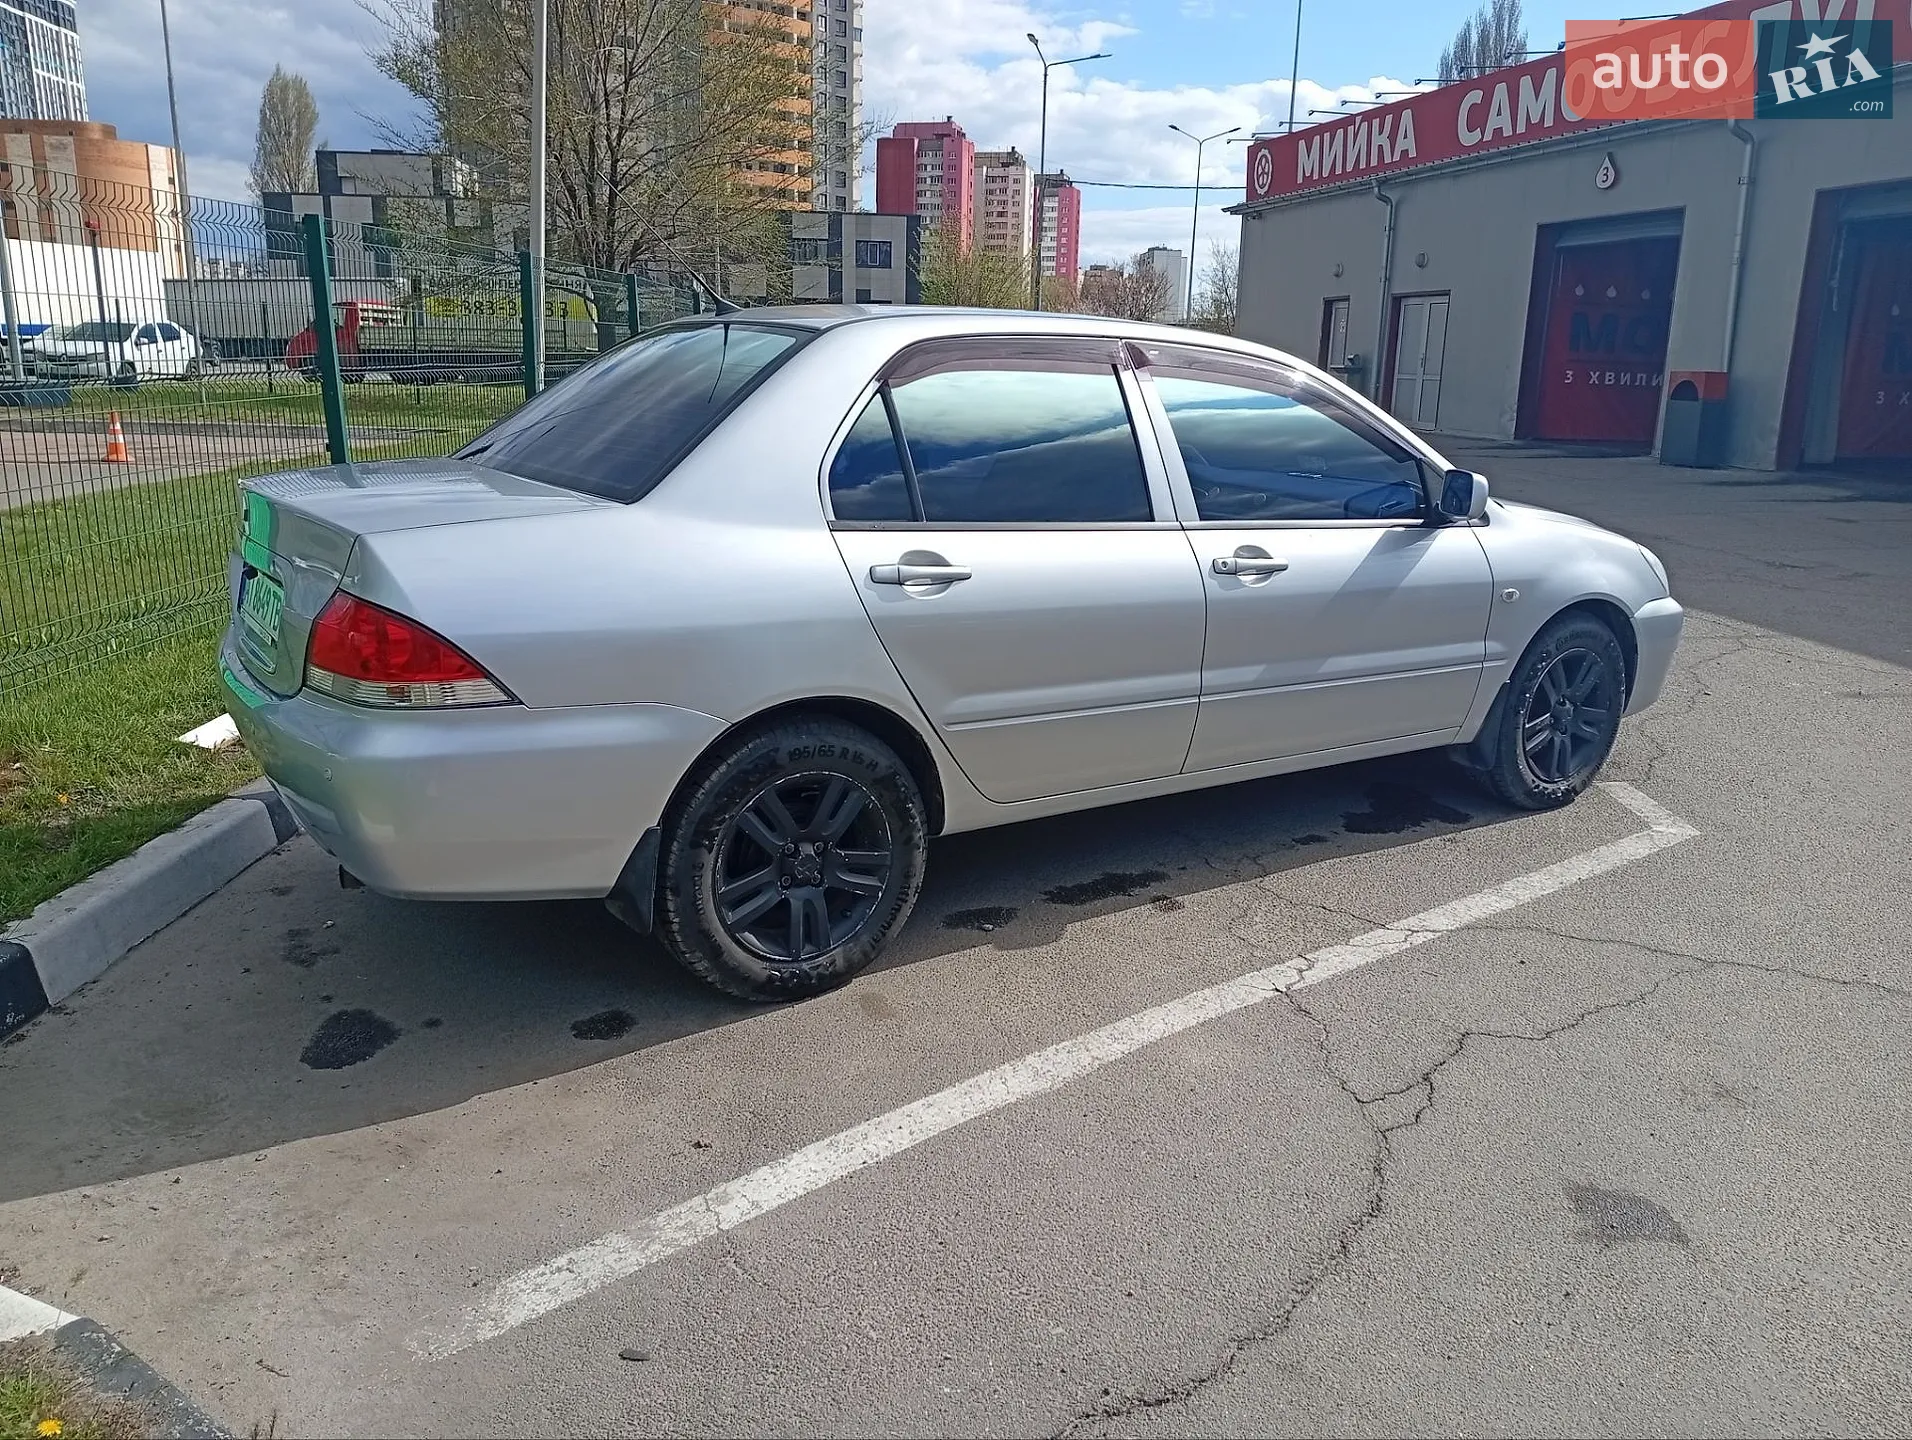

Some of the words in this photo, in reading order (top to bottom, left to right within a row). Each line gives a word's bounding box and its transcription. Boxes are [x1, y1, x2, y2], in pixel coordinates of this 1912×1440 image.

[1297, 108, 1417, 184] МИЙКА
[1602, 166, 1610, 183] 3
[1564, 370, 1574, 383] 3
